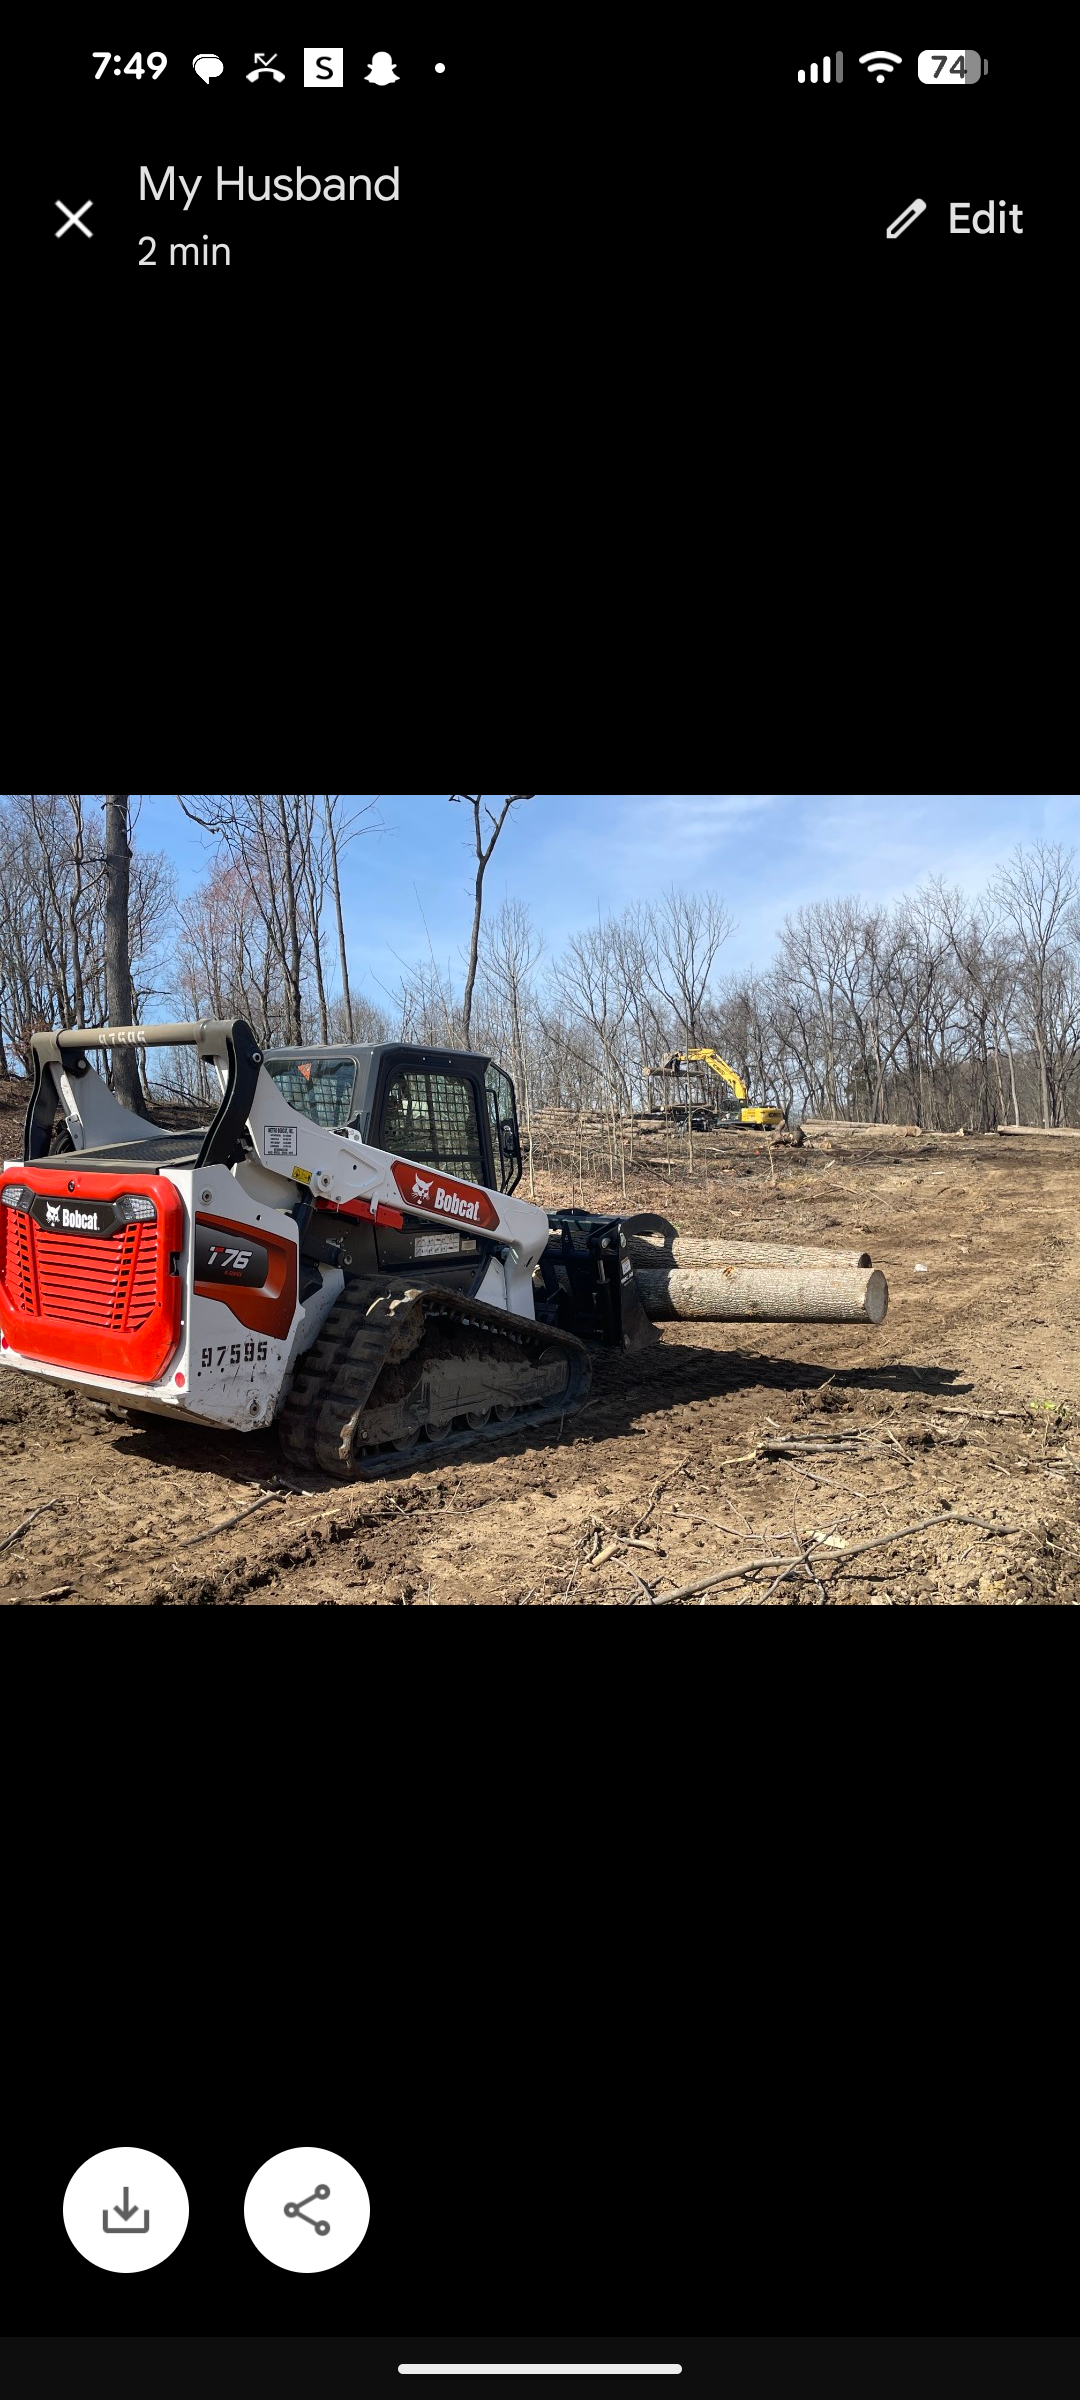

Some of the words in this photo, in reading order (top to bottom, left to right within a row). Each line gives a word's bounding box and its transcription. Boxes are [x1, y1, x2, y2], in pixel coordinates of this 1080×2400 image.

[434, 1187, 480, 1221] Bobcat
[62, 1208, 99, 1231] Bobcat
[207, 1246, 253, 1269] T76
[201, 1341, 268, 1368] 97595
